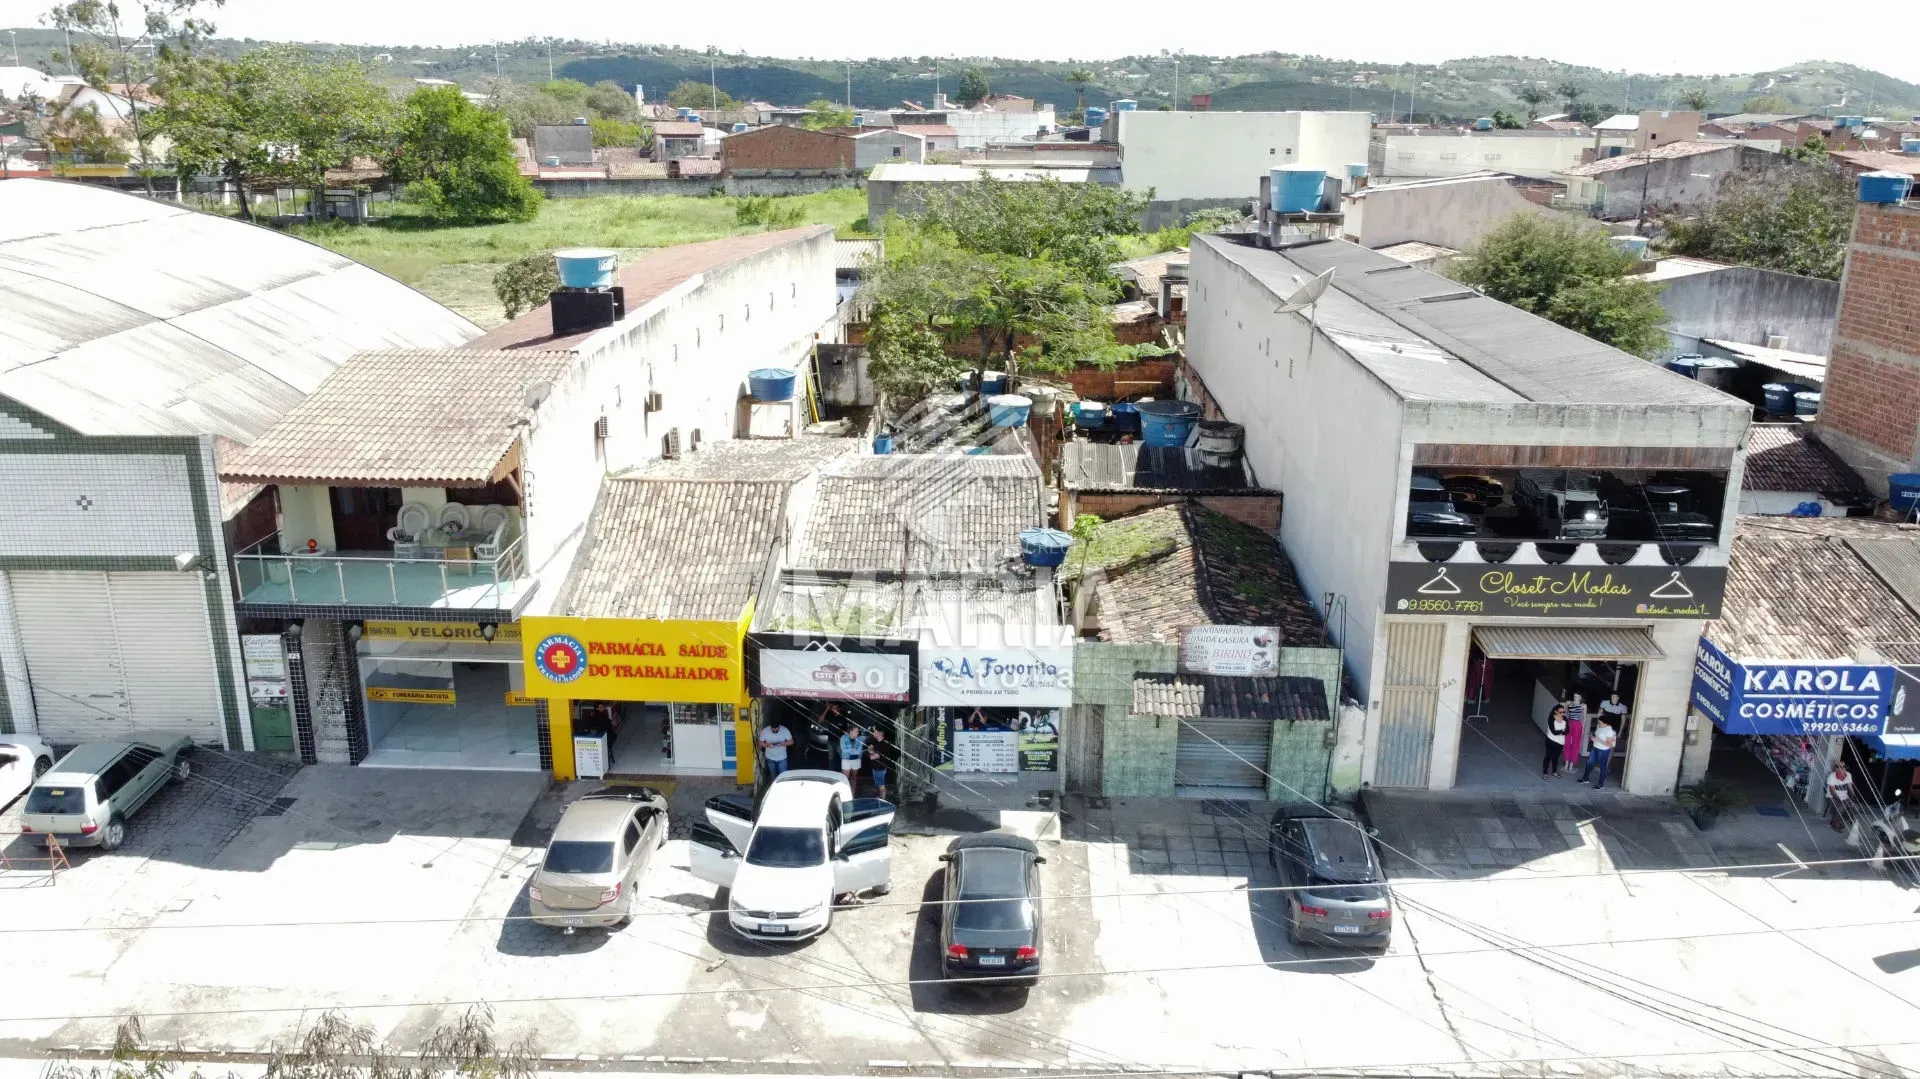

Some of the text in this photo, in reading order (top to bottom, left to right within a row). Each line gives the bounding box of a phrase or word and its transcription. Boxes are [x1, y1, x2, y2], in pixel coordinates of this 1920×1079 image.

[1479, 570, 1632, 595] Closet Modas
[1408, 599, 1484, 612] 9.9560-7761
[1530, 600, 1559, 614] sempre
[1574, 598, 1598, 608] moda
[408, 622, 483, 639] VELÓRIO
[588, 638, 728, 659] FARMÁCIA SAÚDE
[588, 664, 729, 681] DO TRABALHADOR
[960, 657, 975, 679] A
[1697, 645, 1732, 684] KAROLA
[1695, 665, 1730, 701] COSMÉTICOS
[1743, 670, 1881, 692] KAROLA
[426, 691, 449, 699] BATISTA
[1739, 700, 1880, 719] COSMÉTICOS
[1802, 723, 1869, 733] 9.9920.6366
